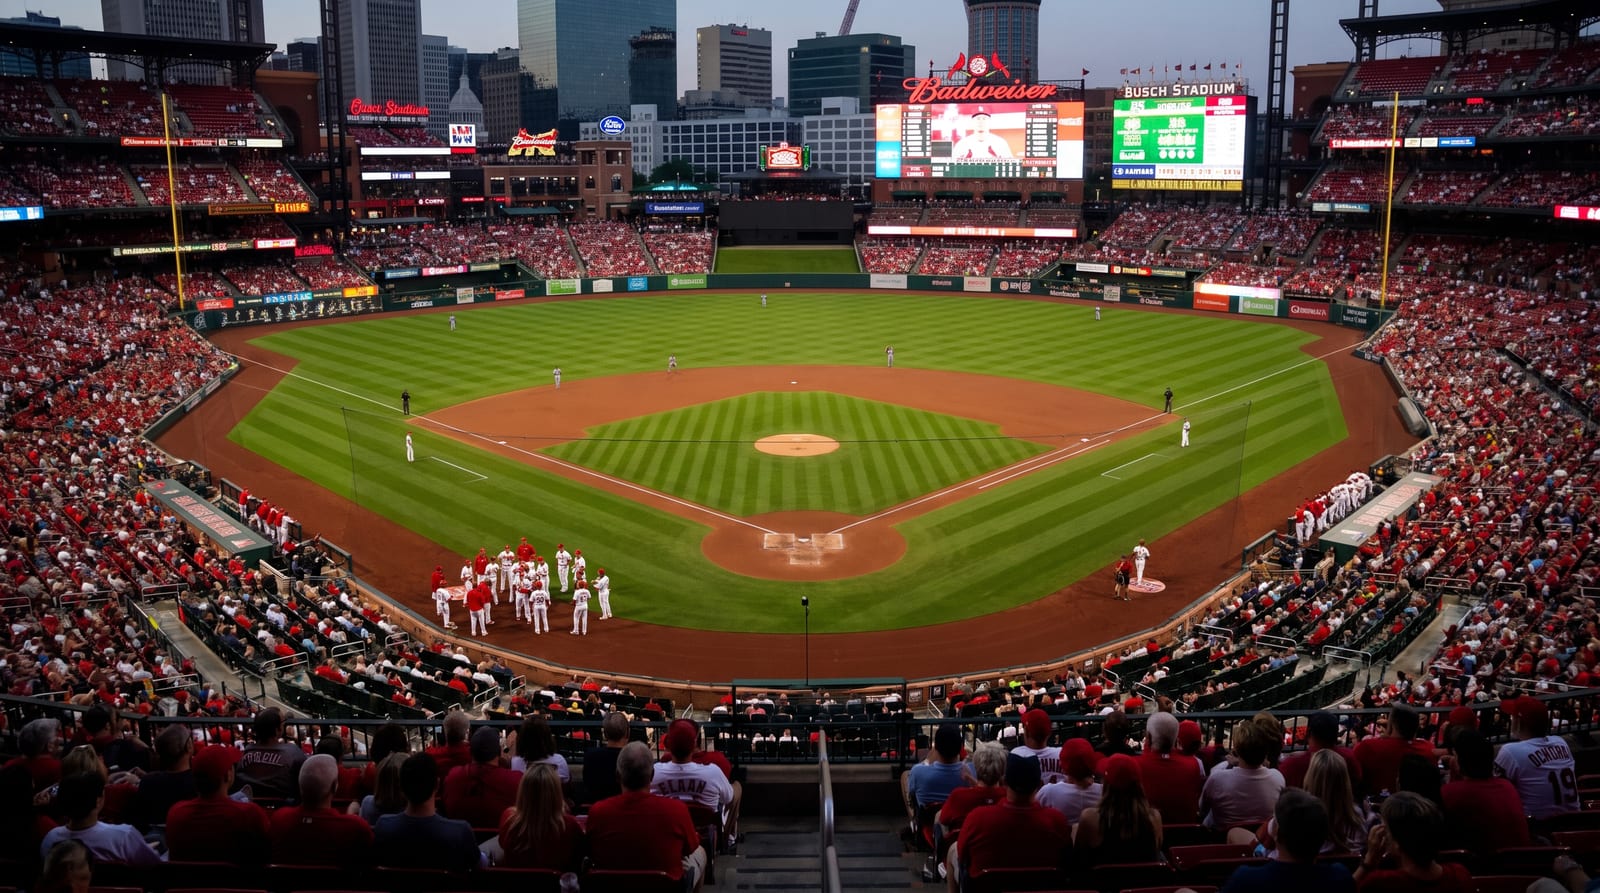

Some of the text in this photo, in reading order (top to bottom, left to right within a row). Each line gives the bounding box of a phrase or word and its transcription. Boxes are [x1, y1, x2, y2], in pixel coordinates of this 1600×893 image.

[1124, 83, 1236, 98] BUSCH STADIUM
[1548, 768, 1577, 805] 19
